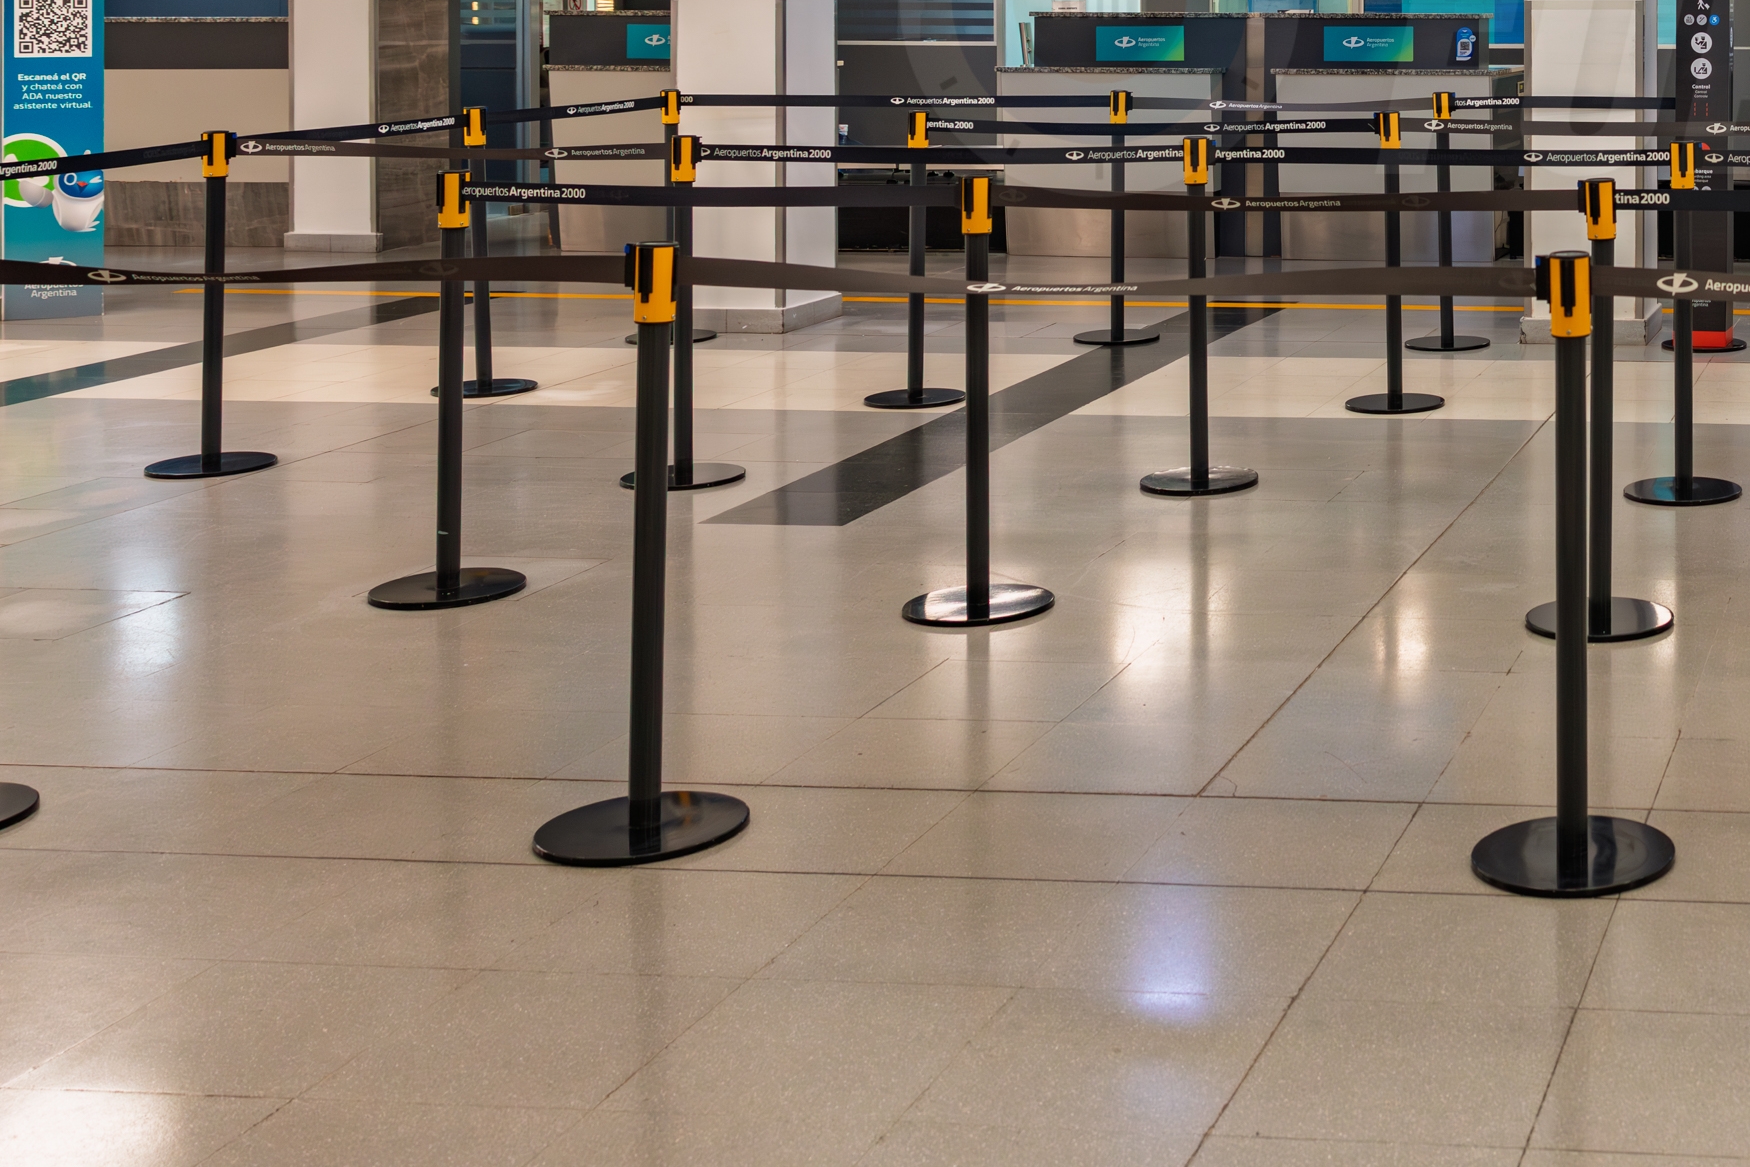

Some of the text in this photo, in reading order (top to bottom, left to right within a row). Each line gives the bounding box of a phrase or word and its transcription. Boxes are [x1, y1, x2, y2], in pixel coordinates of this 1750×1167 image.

[17, 73, 58, 81] Escaneá
[72, 73, 86, 81] QR
[21, 84, 28, 92] y
[13, 102, 57, 110] asistente
[714, 147, 832, 159] Aeropuertos Argentina 2000
[1546, 151, 1670, 164] Aeropuertos Argentina 2000
[509, 186, 561, 199] Argentina
[561, 188, 586, 199] 2000
[1640, 193, 1670, 204] 2000
[31, 289, 77, 299] Argentina
